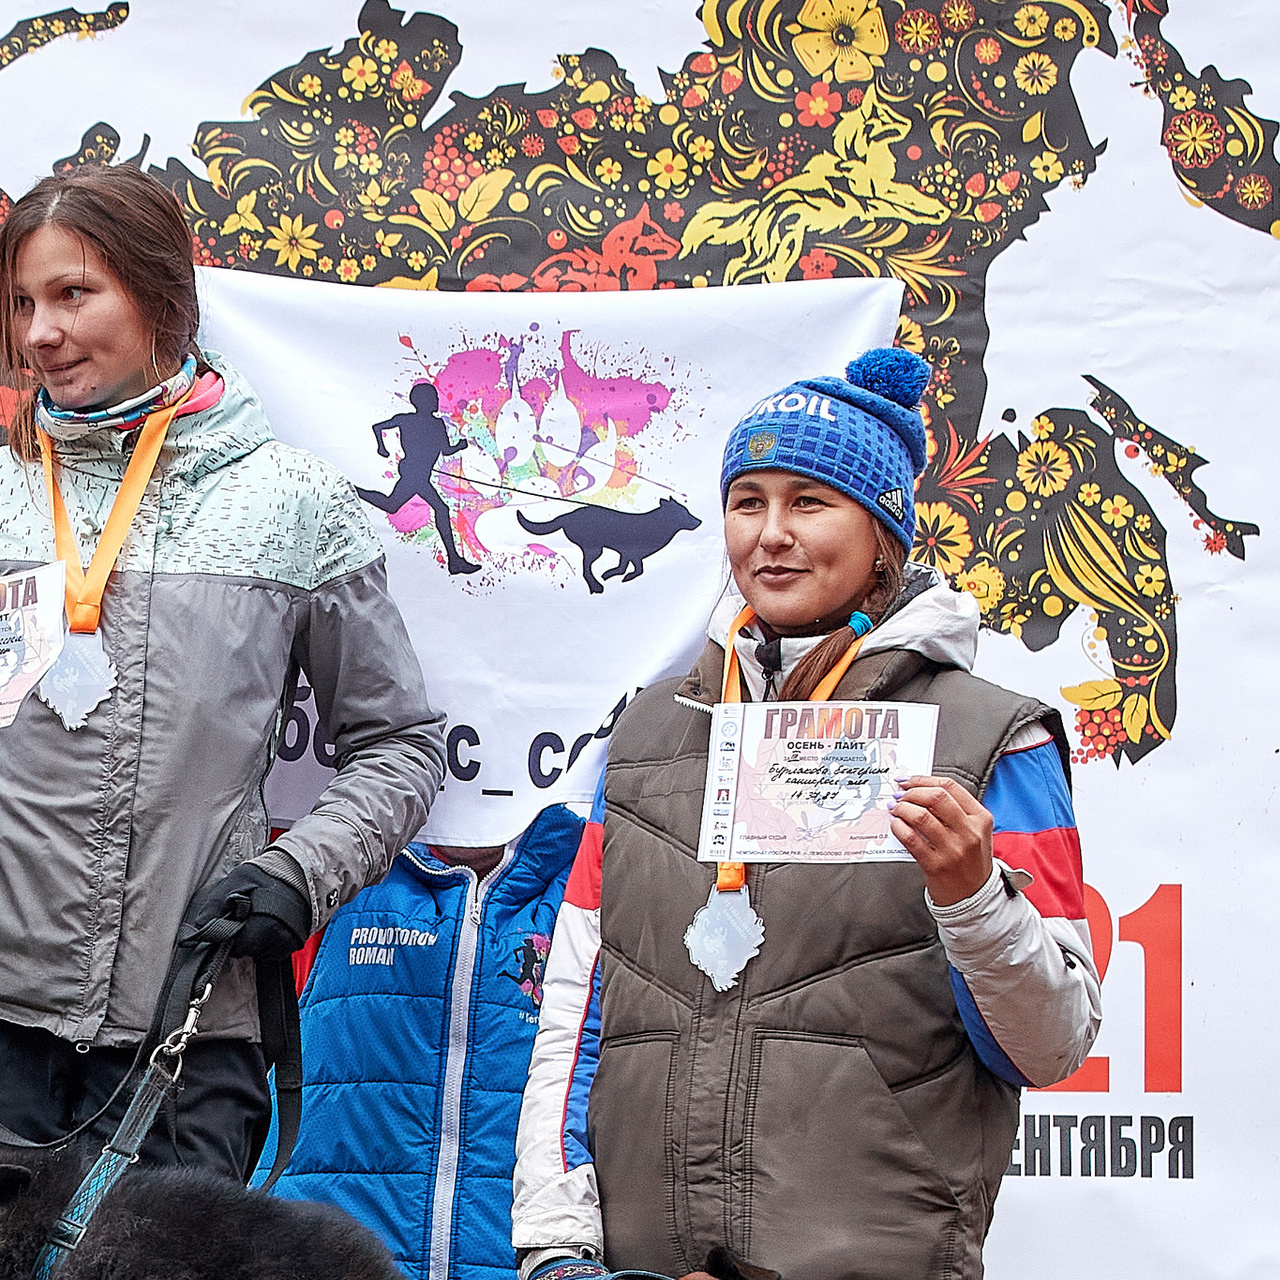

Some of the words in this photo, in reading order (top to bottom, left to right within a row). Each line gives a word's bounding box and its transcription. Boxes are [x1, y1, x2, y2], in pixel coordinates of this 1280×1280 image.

[764, 707, 900, 740] ГРАМОТА
[787, 741, 825, 750] ОСЕНЬ
[834, 740, 866, 750] ЛАЙТ
[349, 947, 395, 966] ROMAN
